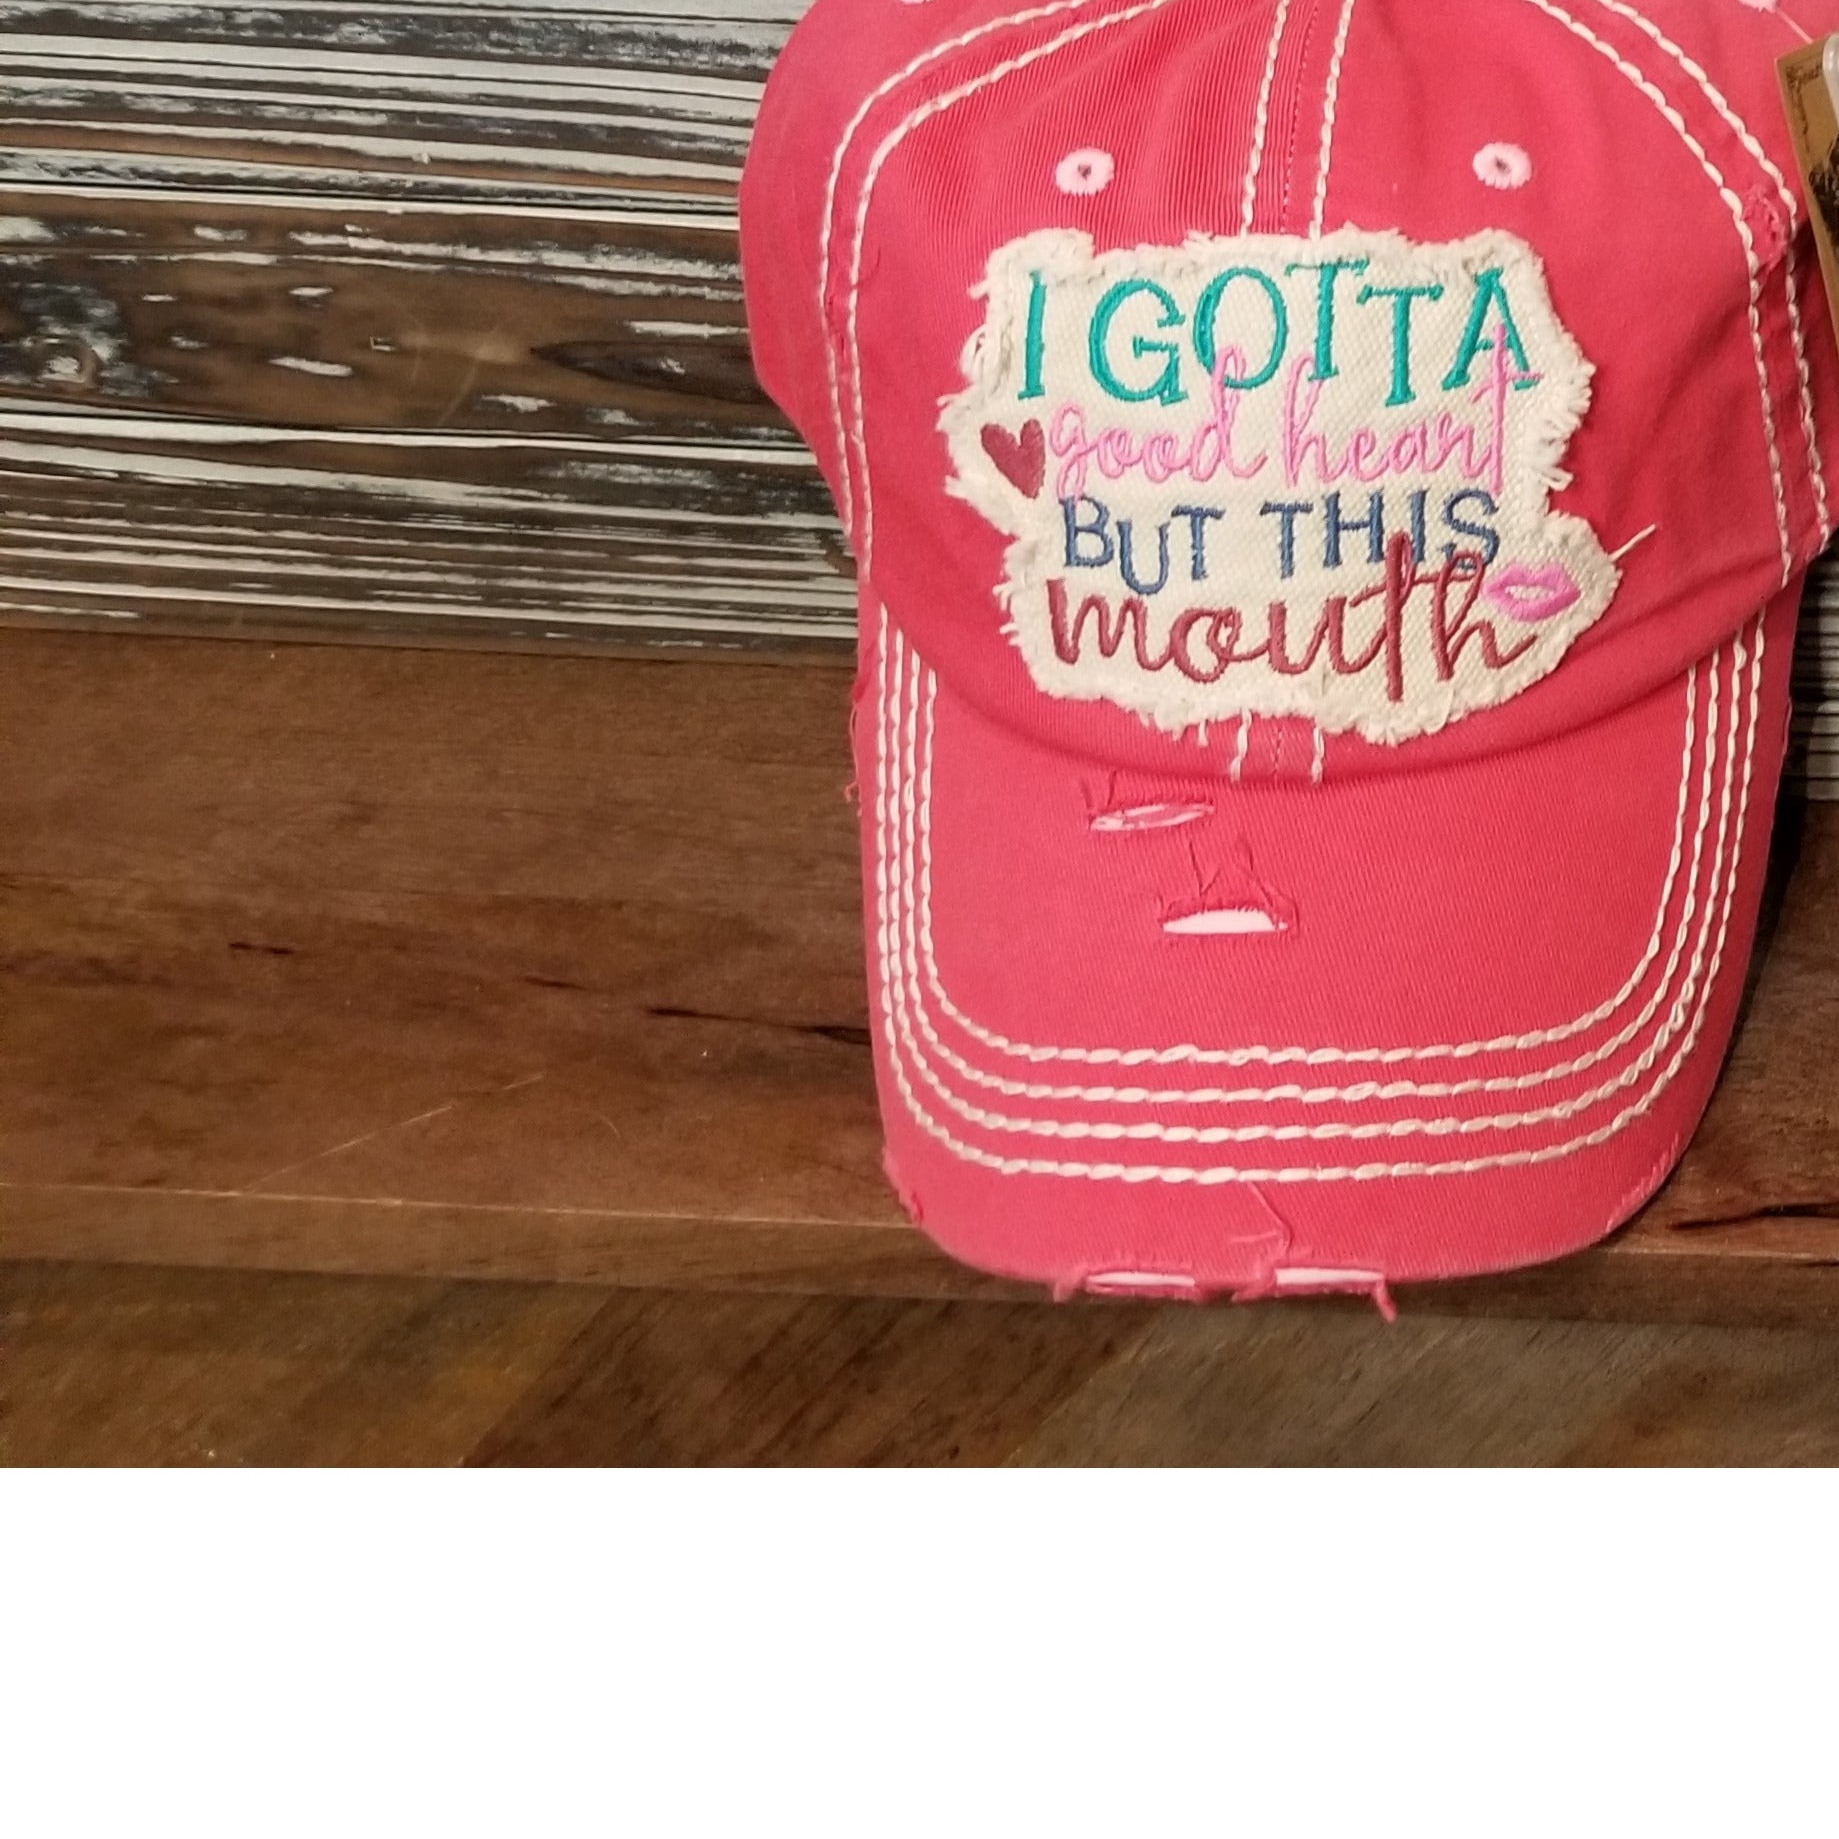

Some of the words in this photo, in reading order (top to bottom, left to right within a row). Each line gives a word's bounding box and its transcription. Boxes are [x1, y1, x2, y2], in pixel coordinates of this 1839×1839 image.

[1018, 271, 1047, 400] I
[1089, 258, 1537, 407] GOTTA
[1049, 344, 1267, 500] good
[1282, 325, 1543, 494] heart
[1046, 531, 1536, 702] mouth
[1062, 495, 1226, 595] BUT
[1261, 489, 1500, 577] THIS
